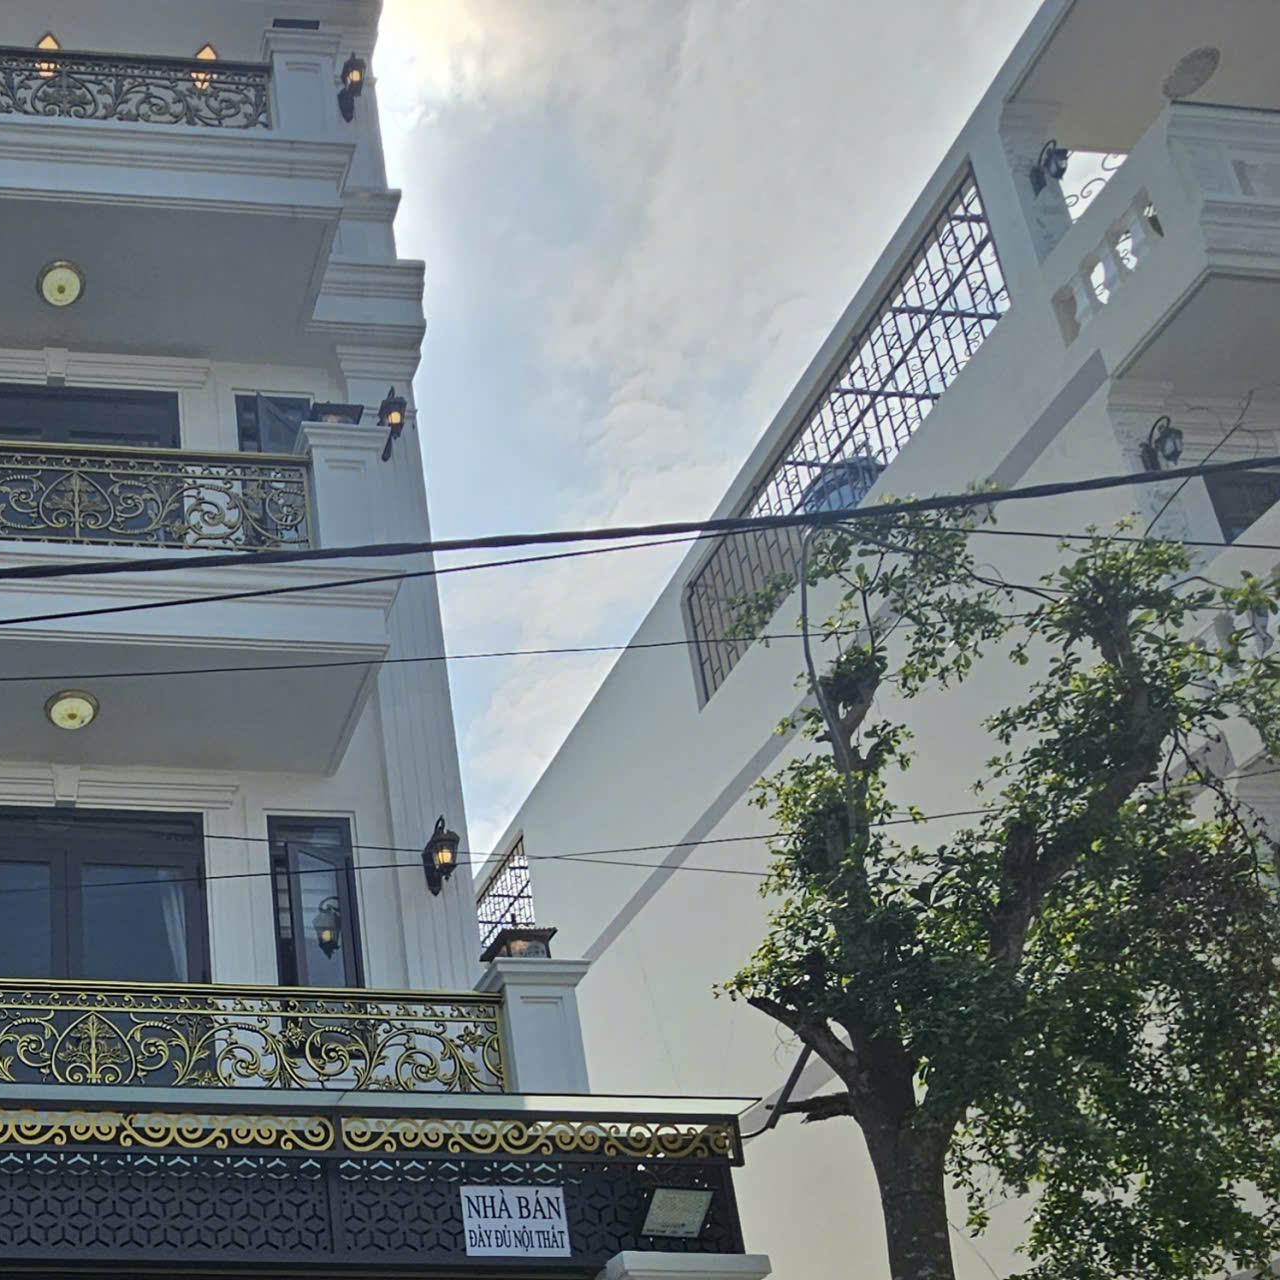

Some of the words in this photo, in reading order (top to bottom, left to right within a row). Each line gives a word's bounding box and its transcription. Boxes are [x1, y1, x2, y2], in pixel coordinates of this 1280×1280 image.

[464, 1189, 513, 1219] NHÀ
[515, 1190, 562, 1220] BÁN
[495, 1224, 512, 1248] ĐỦ
[513, 1225, 534, 1252] NỘI
[535, 1224, 565, 1248] THẤT
